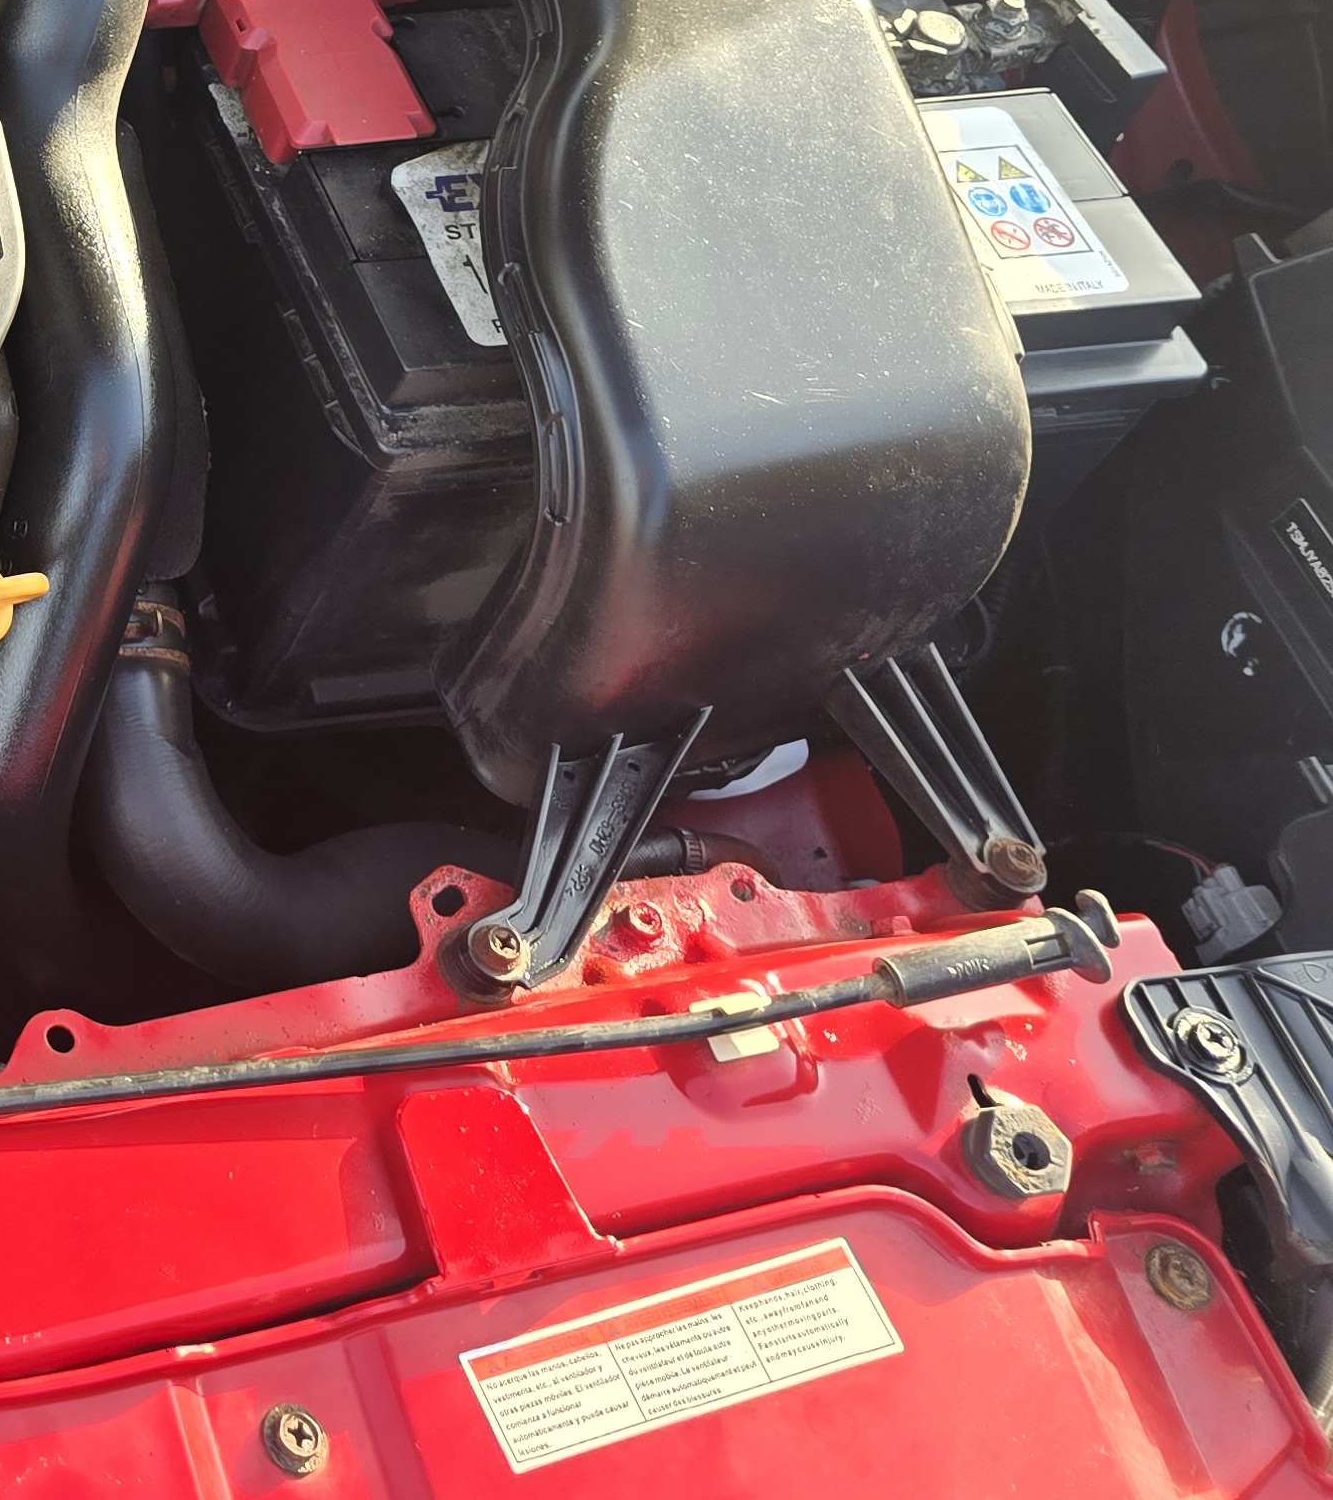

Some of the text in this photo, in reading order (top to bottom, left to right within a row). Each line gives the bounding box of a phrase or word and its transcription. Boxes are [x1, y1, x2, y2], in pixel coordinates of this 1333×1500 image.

[1035, 280, 1104, 294] MADE IN ITALY
[736, 1300, 760, 1314] Keep
[762, 1308, 785, 1322] away
[780, 1301, 803, 1314] from
[799, 1297, 815, 1308] fan
[813, 1293, 829, 1304] and
[750, 1327, 768, 1339] any
[765, 1320, 788, 1334] other
[785, 1311, 817, 1328] moving
[756, 1315, 851, 1351] Fan starts automatically
[624, 1338, 640, 1349] pas
[637, 1325, 677, 1345] approcher
[637, 1355, 677, 1374] ventilateur
[692, 1344, 713, 1356] toute
[689, 1353, 729, 1372] ventilateur
[763, 1351, 781, 1363] and
[778, 1347, 798, 1360] may
[795, 1340, 820, 1353] cause
[497, 1372, 529, 1389] acerque
[558, 1364, 597, 1383] ventilador
[669, 1366, 734, 1394] automatiquement
[738, 1359, 758, 1372] peut
[498, 1405, 519, 1417] otras
[517, 1397, 544, 1412] piezas
[583, 1372, 621, 1390] ventilador
[646, 1401, 673, 1415] causer
[671, 1396, 686, 1407] des
[503, 1413, 541, 1430] comienza
[545, 1398, 583, 1417] funcionar
[579, 1407, 605, 1423] puede
[603, 1400, 630, 1414] causar
